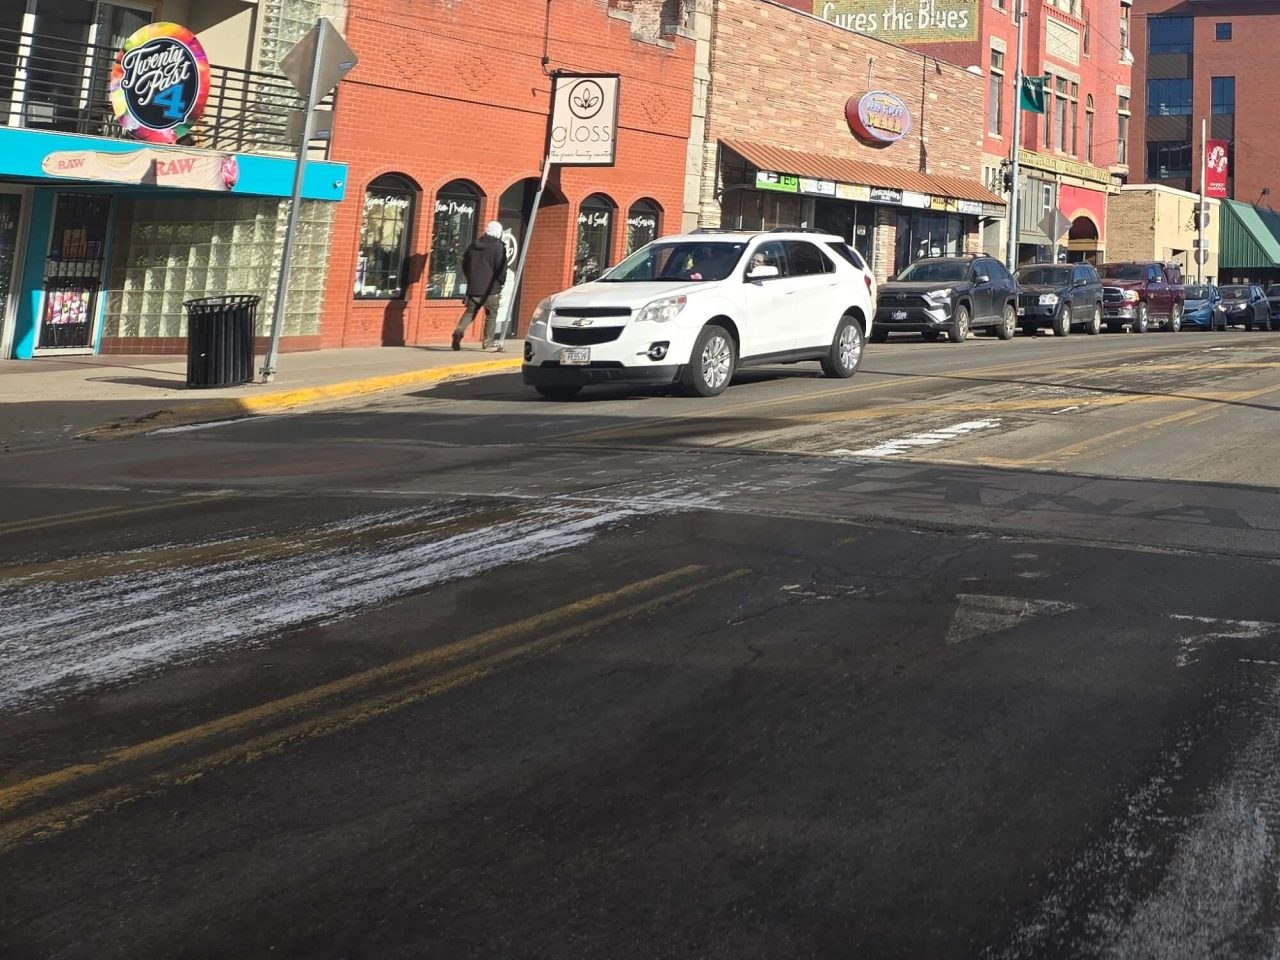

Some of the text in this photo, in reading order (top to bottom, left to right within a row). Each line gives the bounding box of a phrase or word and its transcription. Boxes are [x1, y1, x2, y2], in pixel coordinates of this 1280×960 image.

[822, 2, 877, 31] Cures
[882, 0, 913, 31] the
[123, 44, 184, 88] Twenty
[134, 60, 191, 106] Past
[153, 82, 185, 119] 4
[552, 117, 610, 149] gloss
[58, 158, 197, 177] RAW RAW
